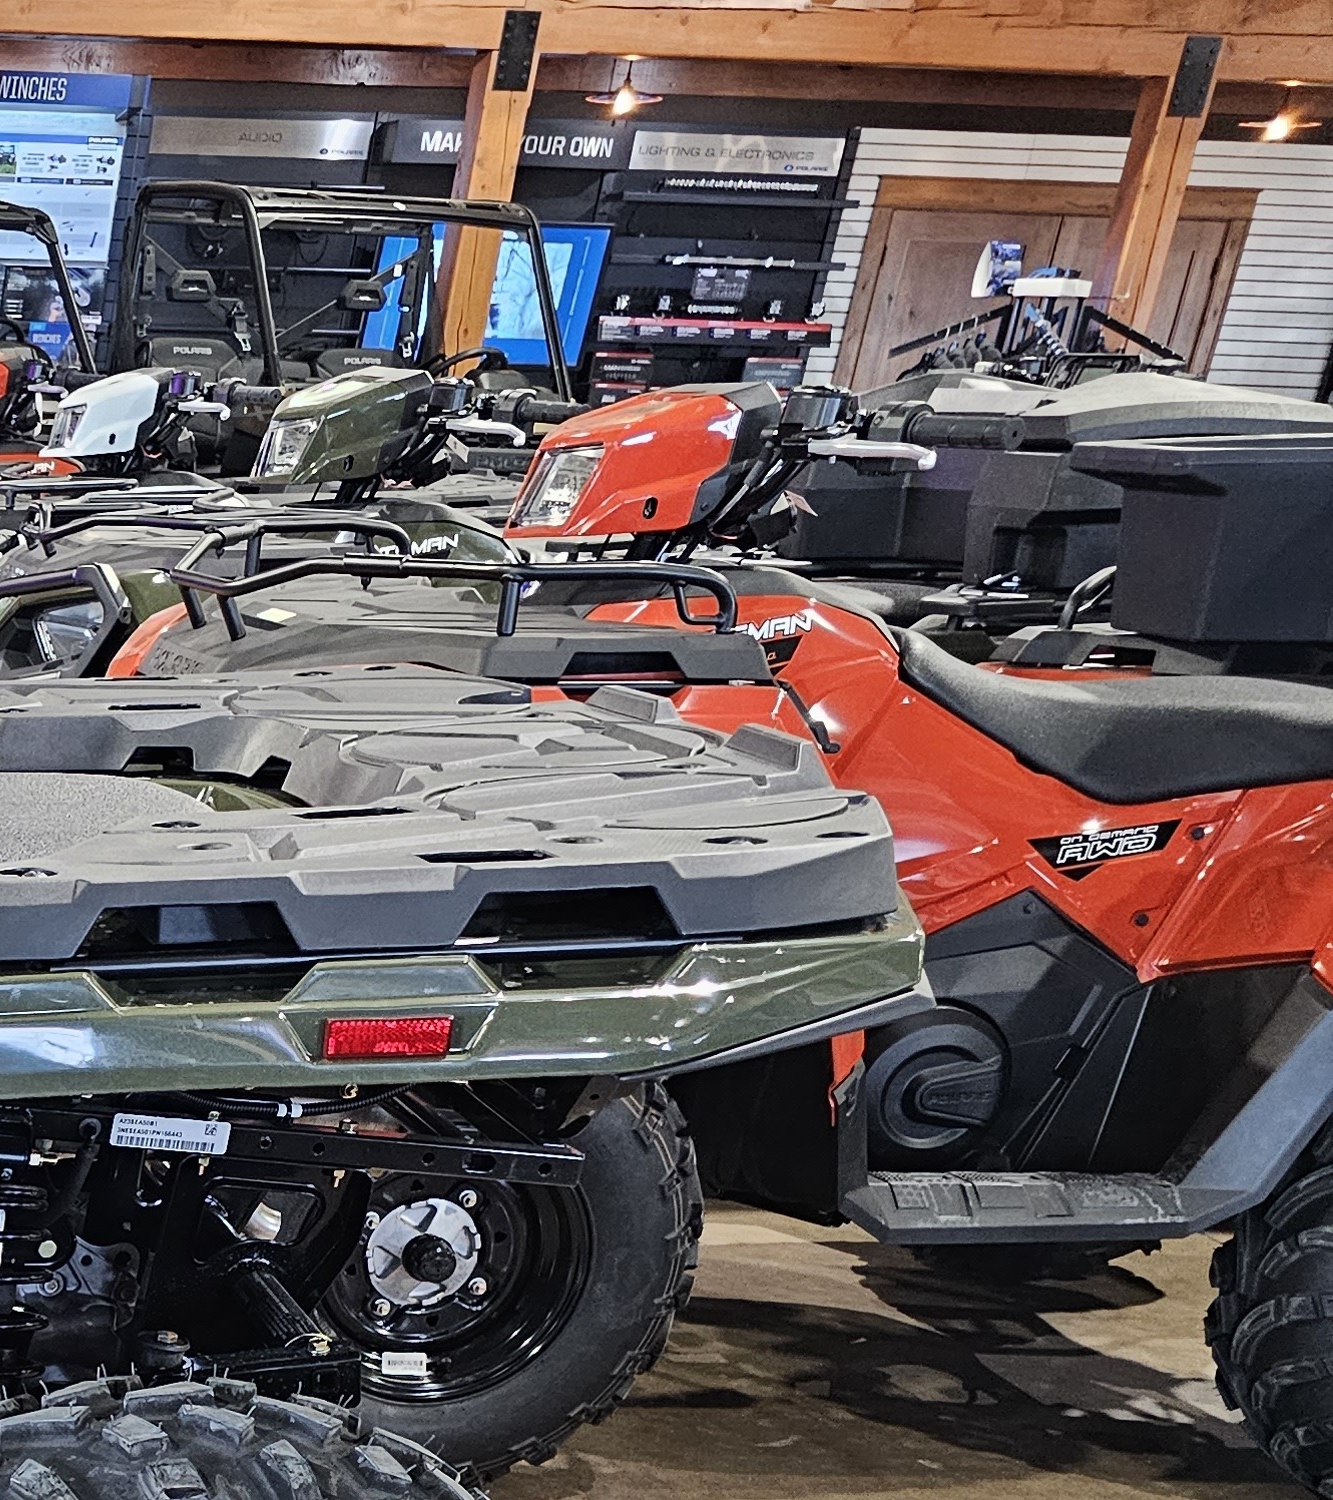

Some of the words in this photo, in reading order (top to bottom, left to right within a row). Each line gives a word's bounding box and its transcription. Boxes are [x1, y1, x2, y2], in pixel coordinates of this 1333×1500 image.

[569, 136, 614, 158] OWN
[638, 145, 701, 158] LIGHTING
[706, 147, 716, 158] &
[720, 148, 815, 162] ELECTRONICS
[173, 346, 213, 355] POLARIS
[344, 356, 382, 366] POLARIS
[1060, 836, 1083, 845] ON
[1088, 825, 1159, 842] DEMAND
[1056, 833, 1157, 864] AWD
